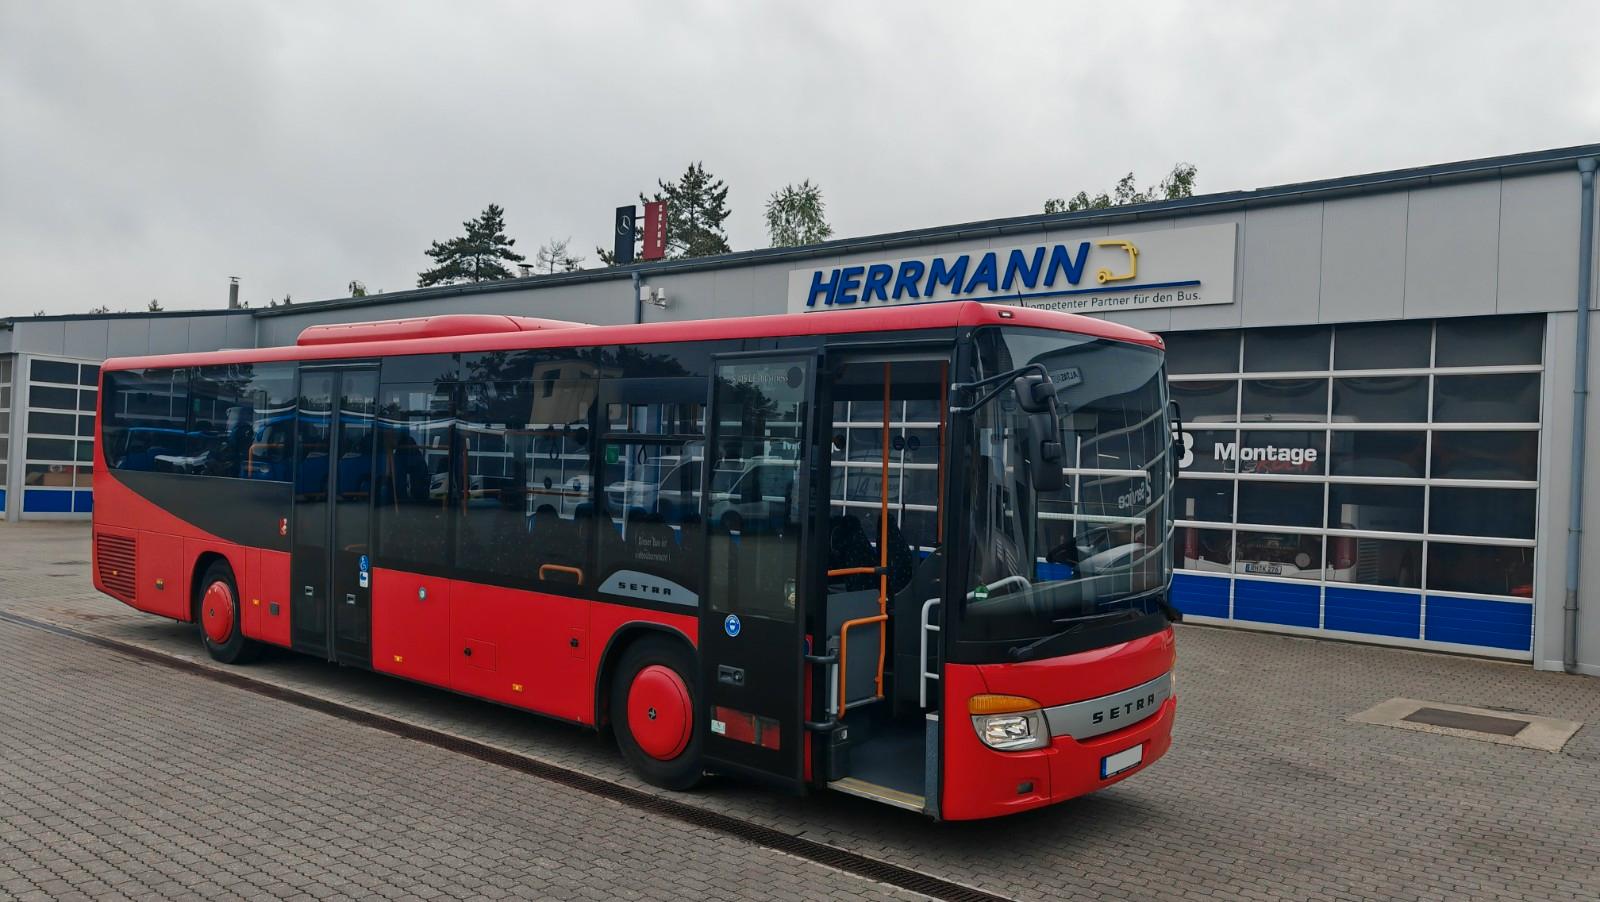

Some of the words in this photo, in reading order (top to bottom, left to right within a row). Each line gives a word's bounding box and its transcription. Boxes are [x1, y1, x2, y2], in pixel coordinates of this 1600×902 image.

[806, 242, 1091, 307] HERRMANN
[1091, 296, 1130, 307] Partner
[1133, 294, 1150, 304] für
[1152, 292, 1173, 303] den
[1177, 291, 1201, 301] Bus.
[1214, 442, 1317, 465] Montage
[618, 581, 672, 595] SETRA
[1092, 693, 1155, 724] SETRA
